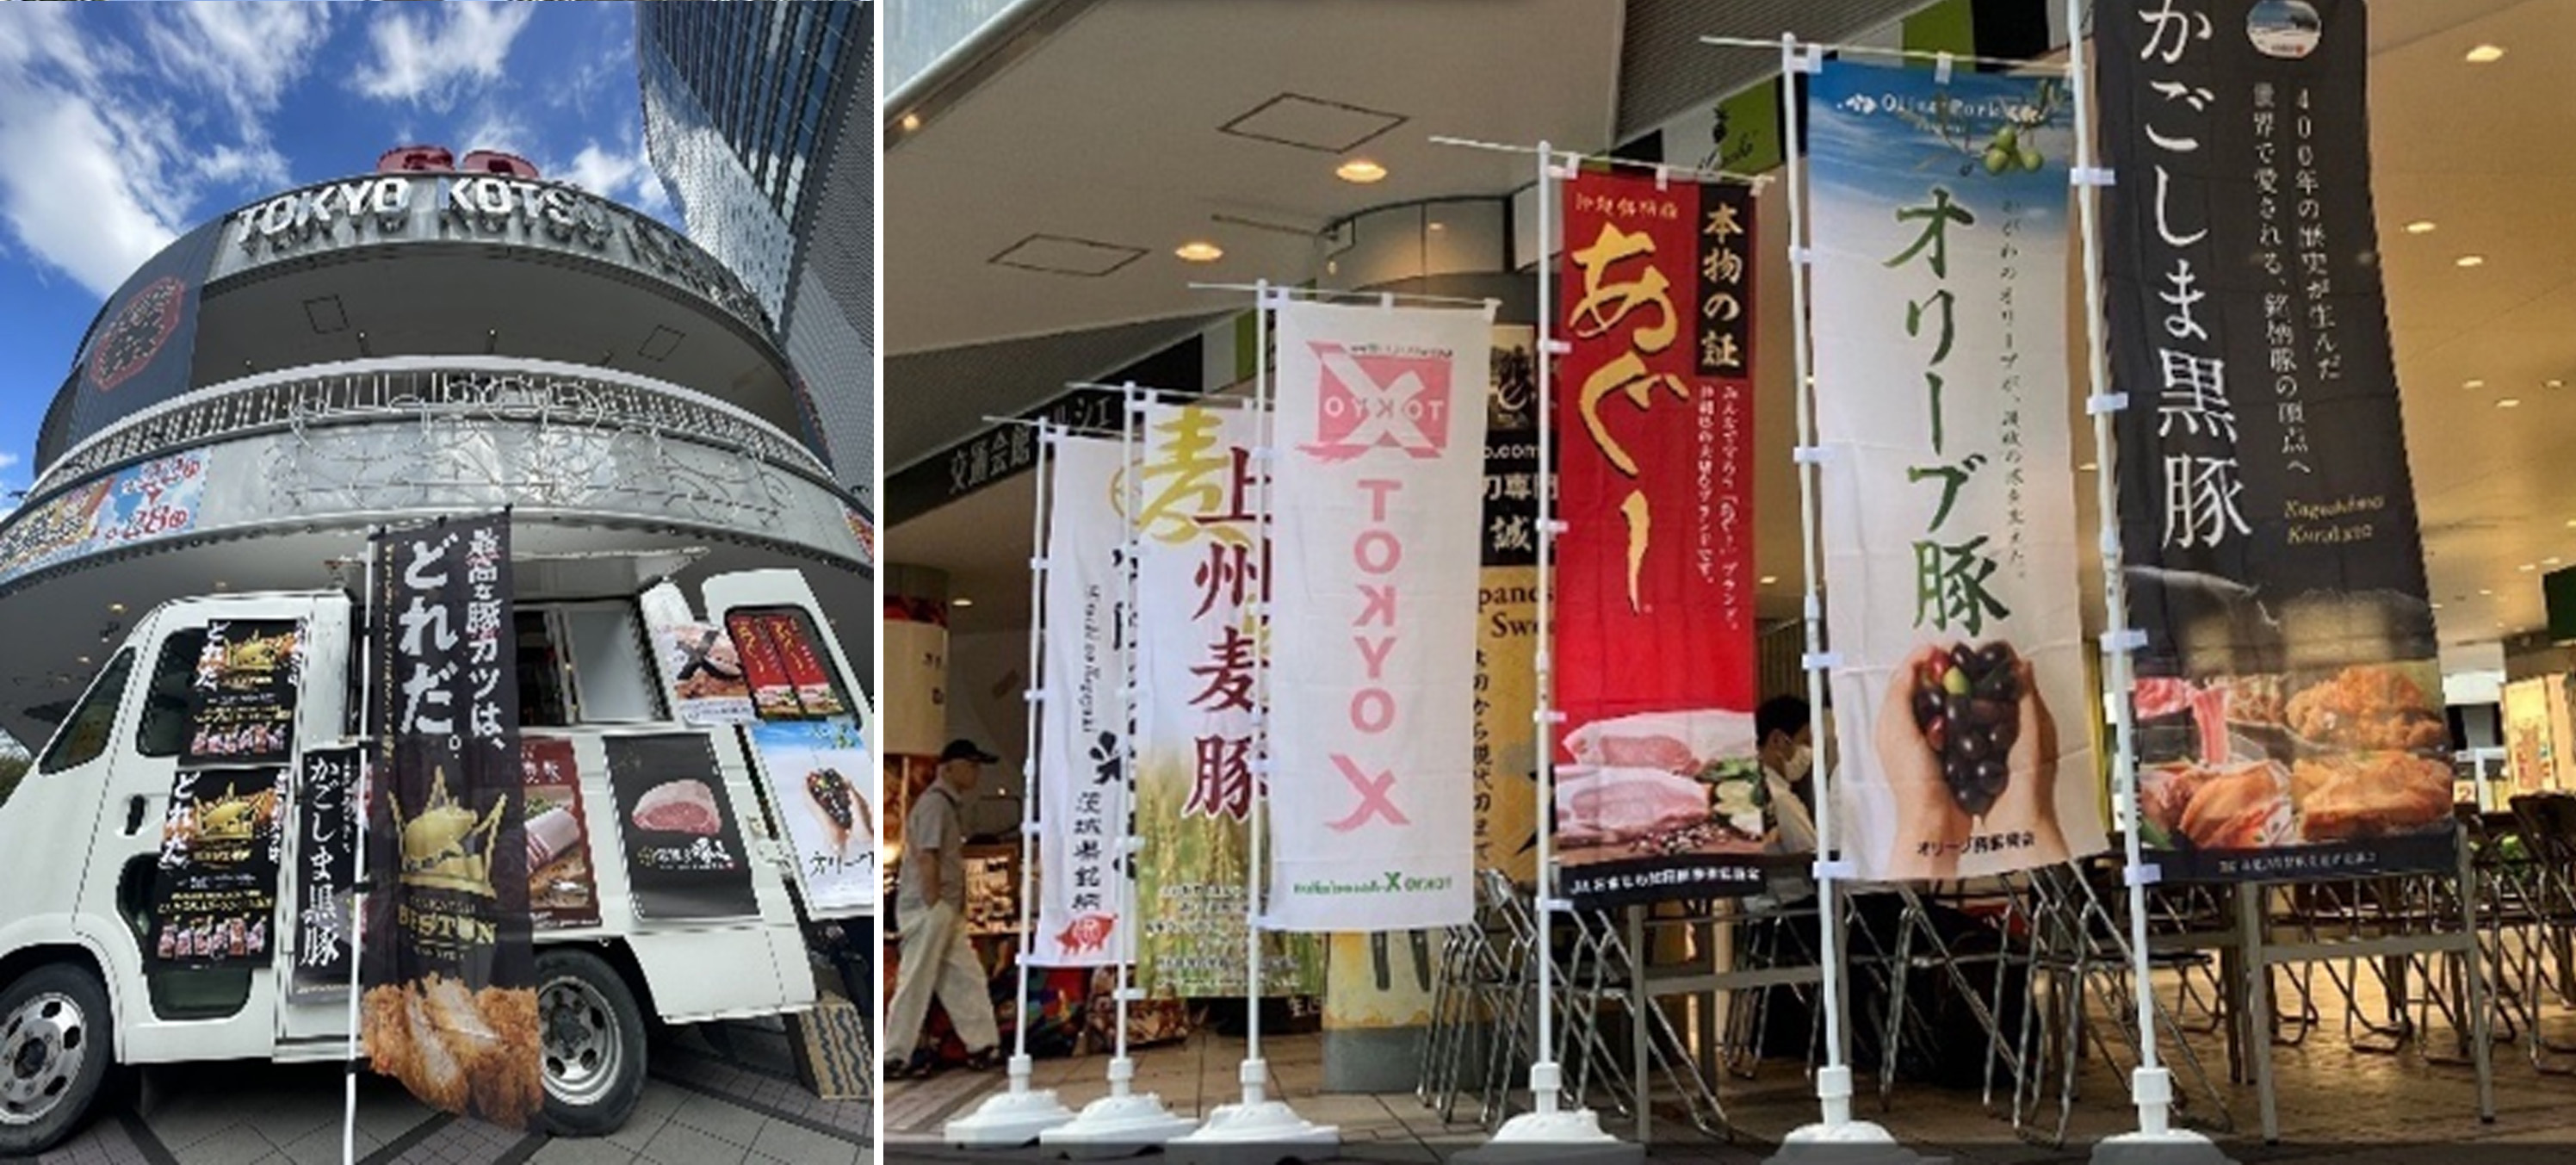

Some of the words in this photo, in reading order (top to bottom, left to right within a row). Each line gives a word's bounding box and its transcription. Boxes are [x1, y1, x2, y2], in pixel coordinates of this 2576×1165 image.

[236, 176, 410, 242] TOKYO
[1700, 202, 1745, 369] 本物の証
[2139, 0, 2251, 549] かごしま黒豚
[2295, 88, 2342, 381] 400年の歴史が生んだ
[1568, 220, 1690, 617] あぐー
[1882, 187, 2010, 638] オリーブ豚
[1182, 444, 1273, 823] 上州麦豚
